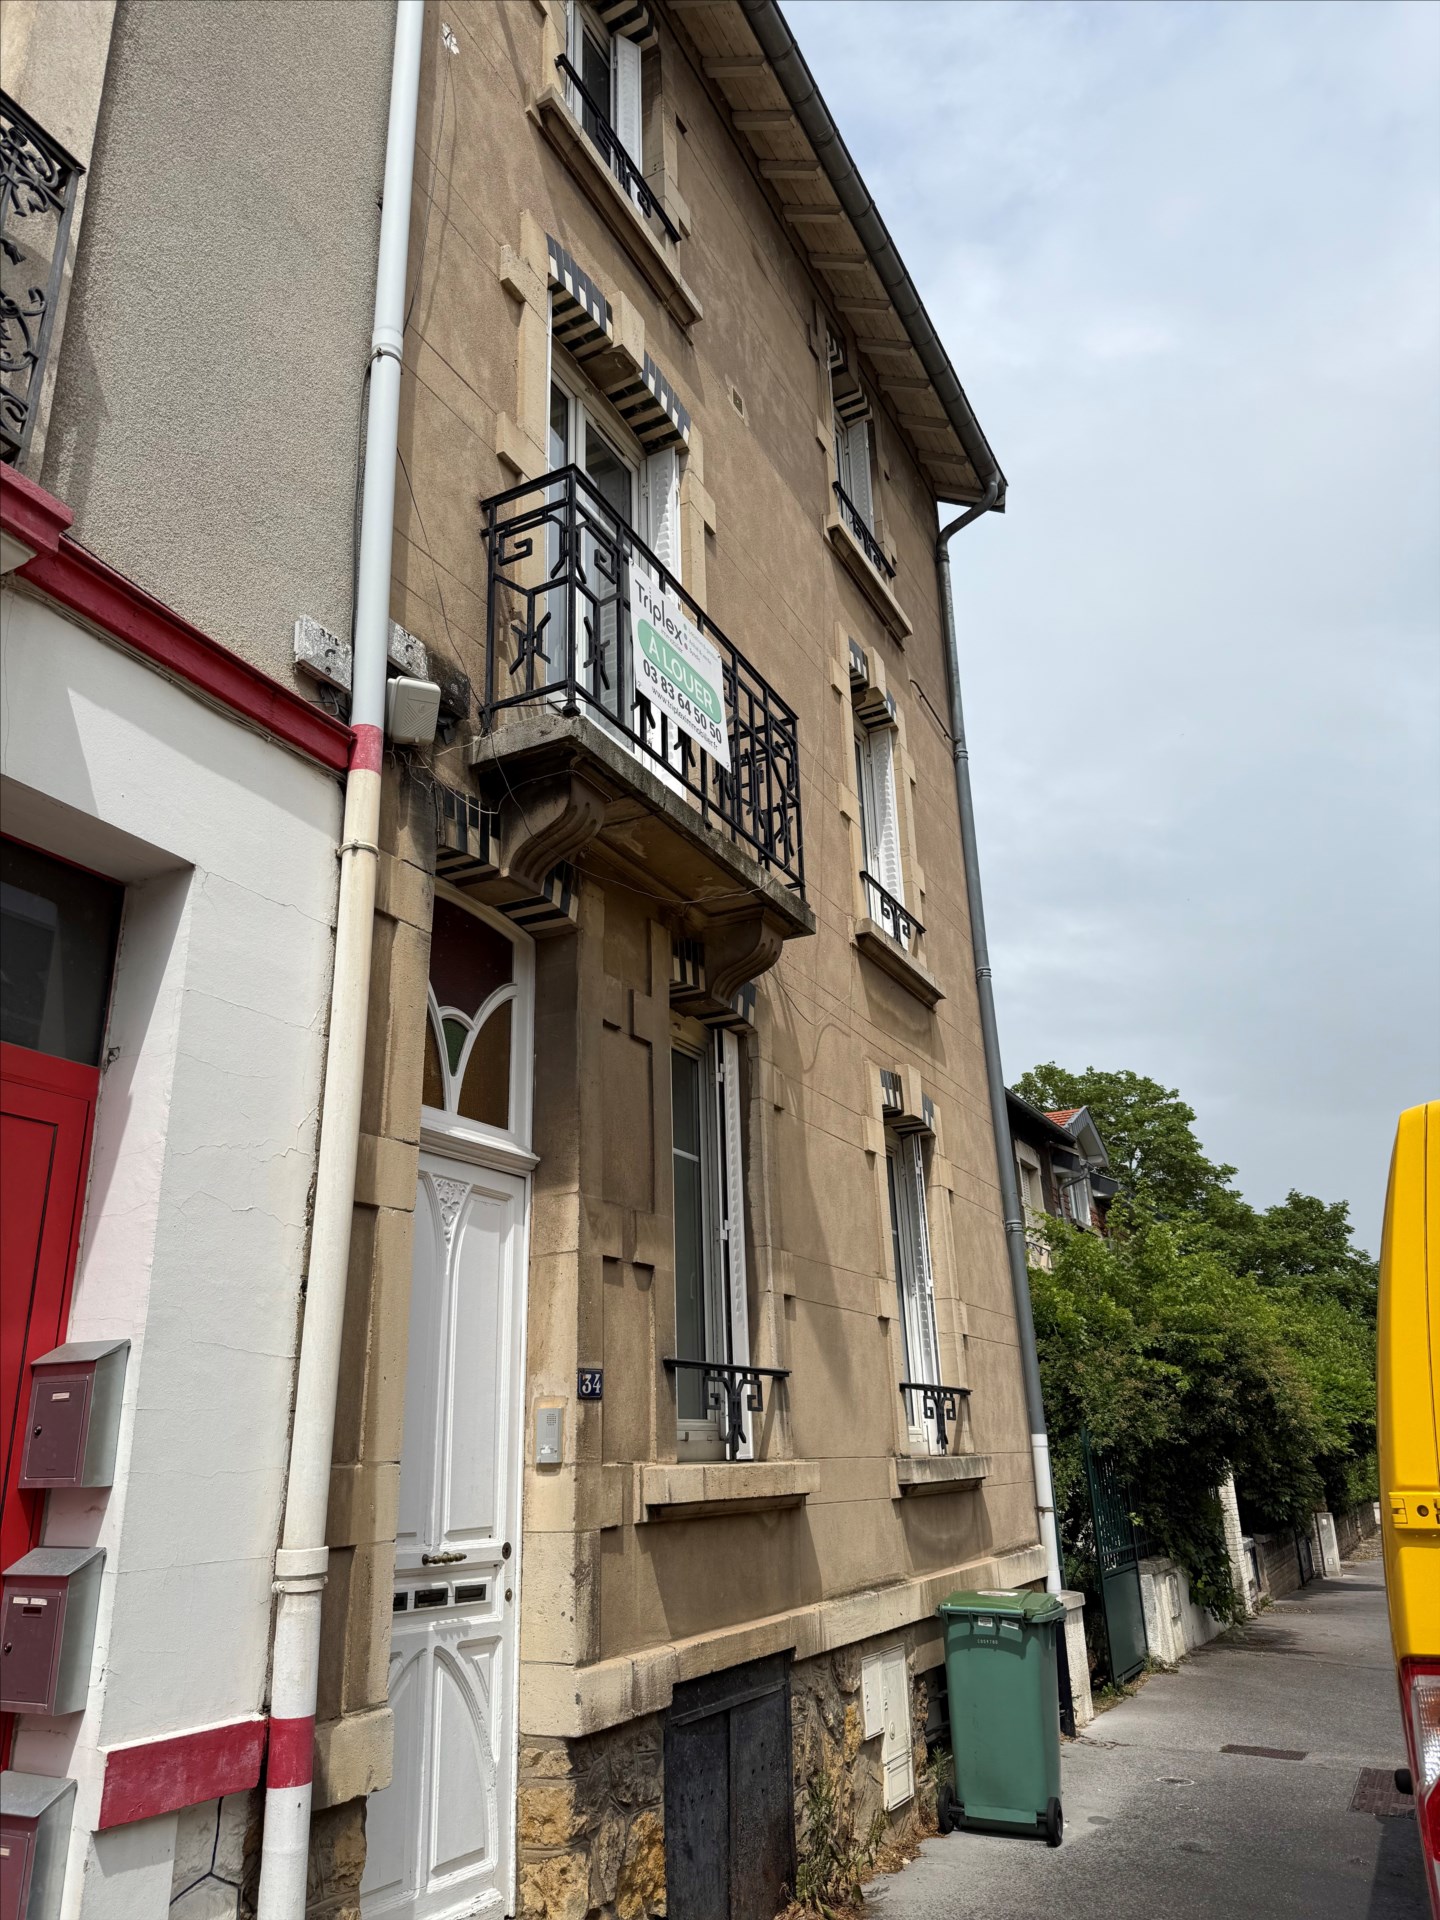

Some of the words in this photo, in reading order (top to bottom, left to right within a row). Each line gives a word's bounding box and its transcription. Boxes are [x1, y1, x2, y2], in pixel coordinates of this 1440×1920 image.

[634, 579, 683, 646] Triplex
[643, 658, 658, 685] 03
[661, 675, 675, 700] 83
[677, 692, 691, 716] 64
[694, 706, 707, 730] 50
[709, 721, 722, 744] 50
[648, 629, 661, 663] À
[662, 647, 714, 714] LOUER
[582, 1373, 601, 1394] 34
